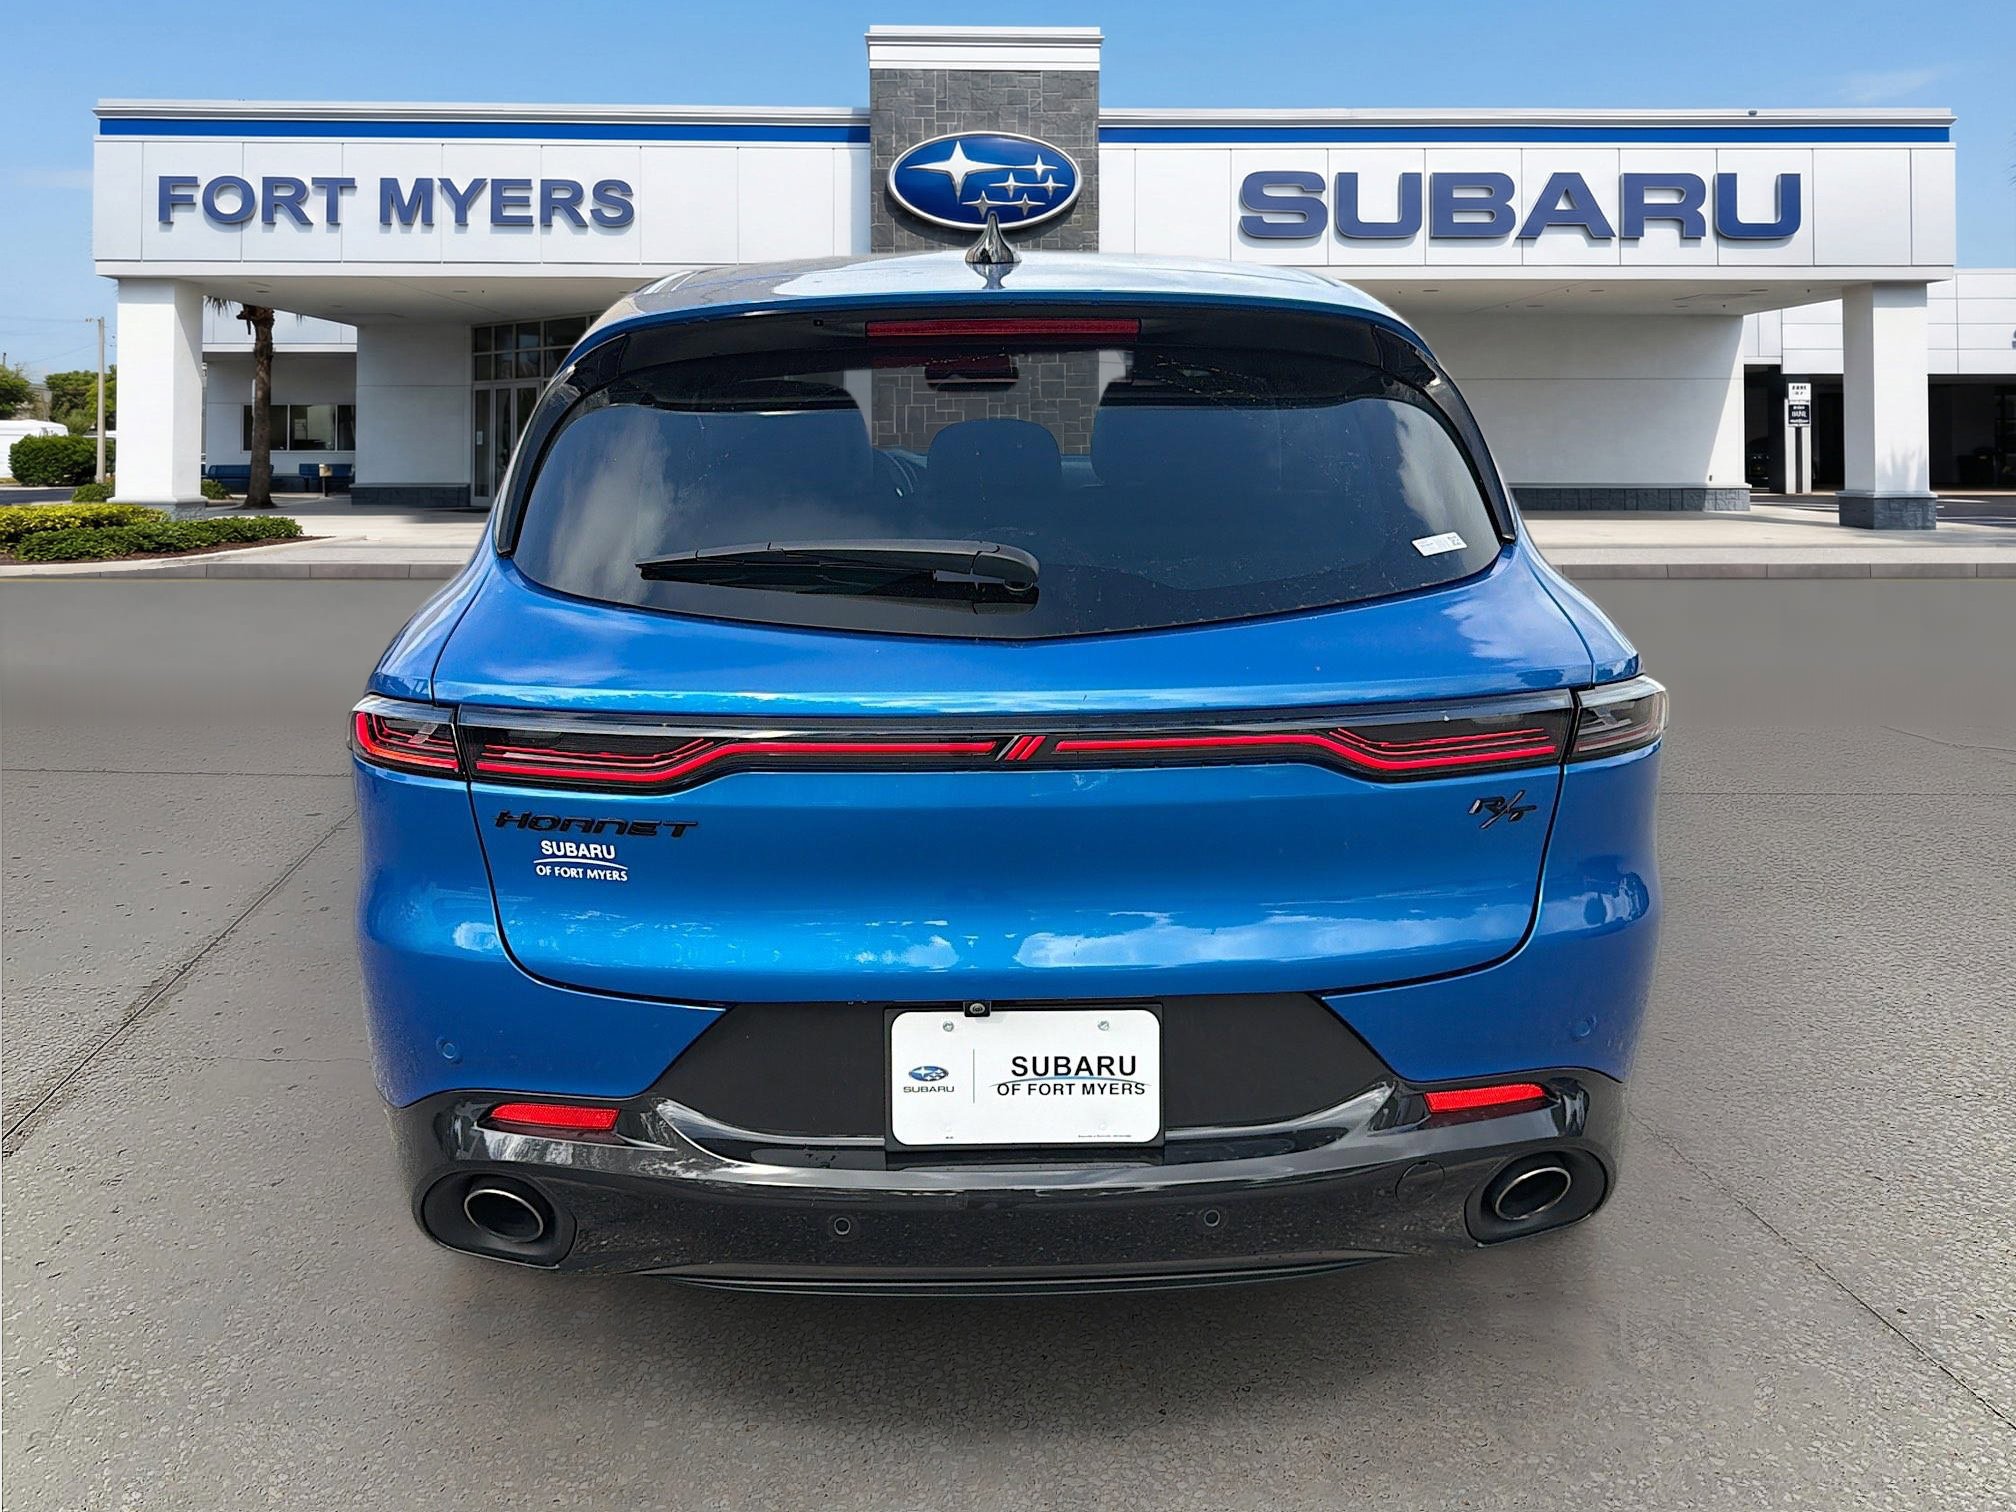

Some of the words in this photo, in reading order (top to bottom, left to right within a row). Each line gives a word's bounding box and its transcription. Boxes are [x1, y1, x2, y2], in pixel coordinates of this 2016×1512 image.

[158, 175, 357, 226] FORT
[378, 177, 636, 228] MYERS
[1239, 170, 1802, 240] SUBARU
[1467, 789, 1537, 829] R/T
[494, 809, 698, 838] HORNET
[540, 840, 616, 860] SUBARU
[535, 865, 552, 877] OF
[554, 866, 584, 879] FORT
[586, 868, 628, 882] MYERS
[1010, 1055, 1137, 1077] SUBARU
[903, 1085, 955, 1094] SUBARU
[996, 1083, 1022, 1096] OF
[1027, 1083, 1076, 1096] FORT
[1081, 1082, 1146, 1096] MYERS
